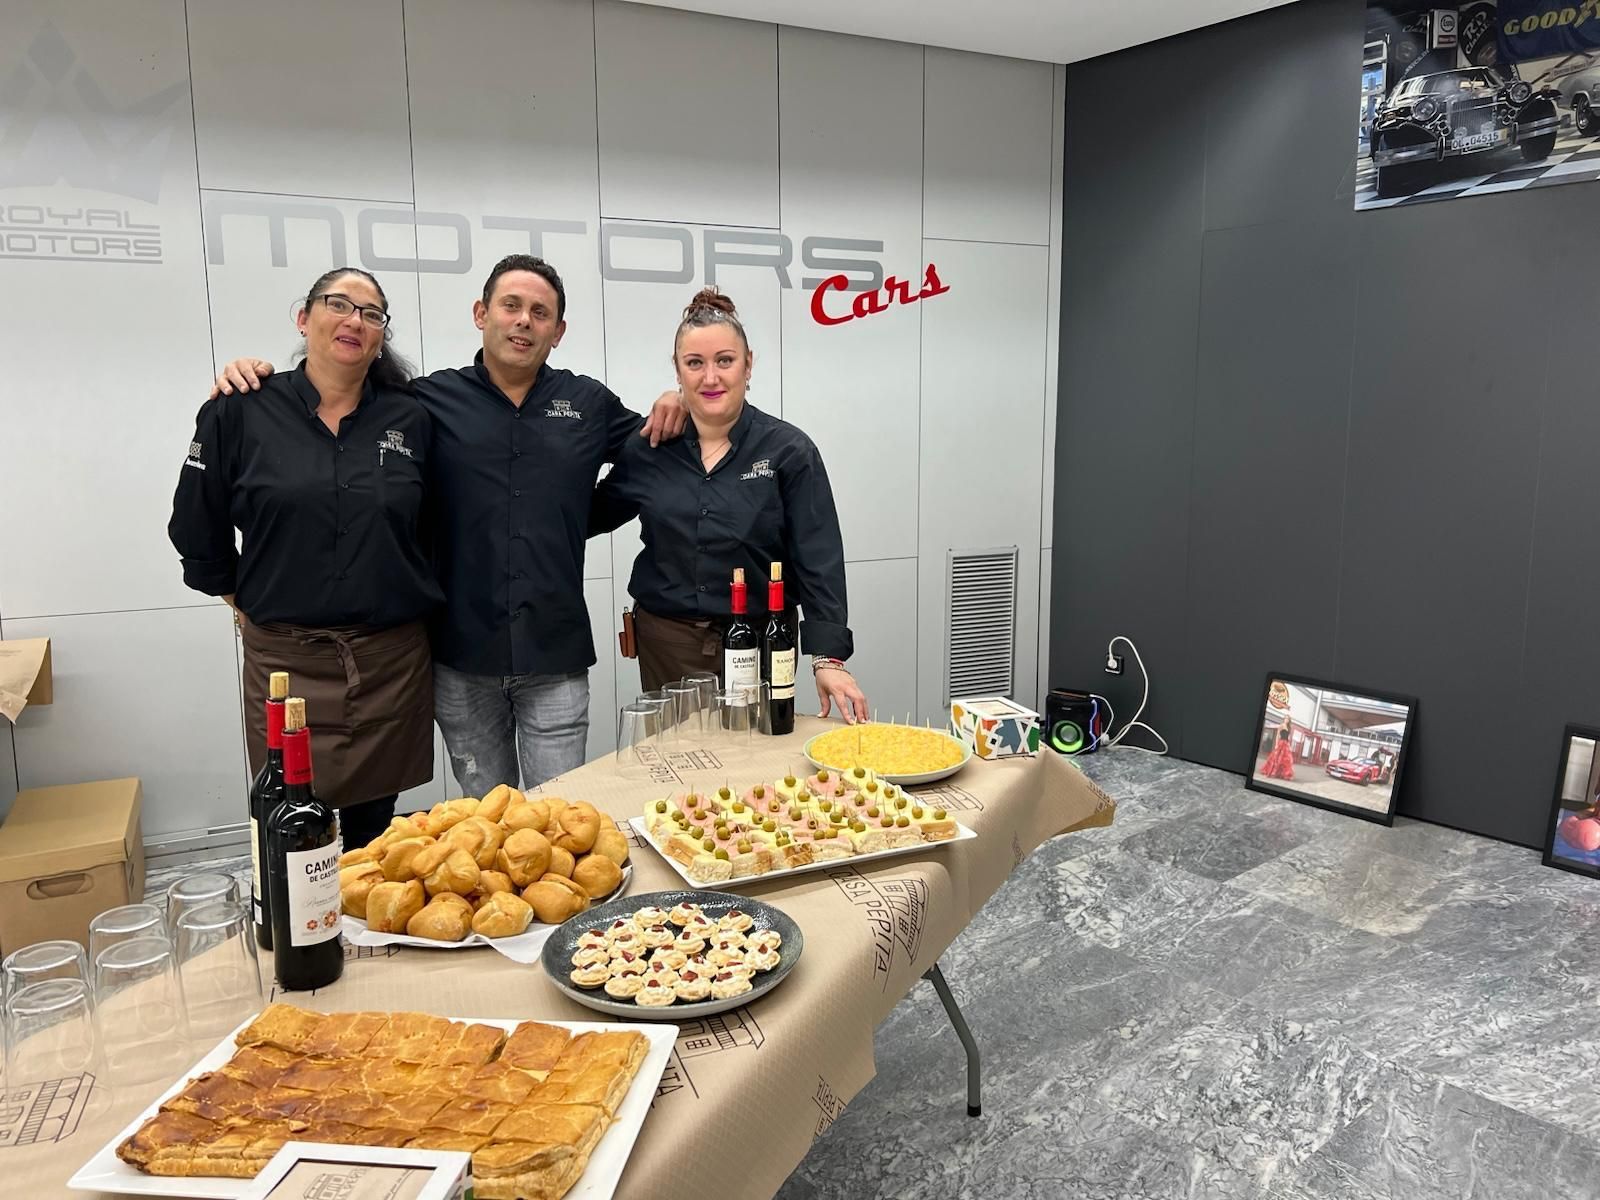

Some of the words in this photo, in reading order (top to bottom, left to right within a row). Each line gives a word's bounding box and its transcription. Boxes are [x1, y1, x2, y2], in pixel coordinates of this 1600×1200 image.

[0, 204, 160, 230] OYAL
[0, 232, 162, 257] OTORS
[203, 202, 884, 292] MOTORS
[810, 263, 950, 326] Cars
[309, 874, 318, 883] DE
[828, 871, 872, 898] CASA
[854, 899, 893, 973] PEPITA
